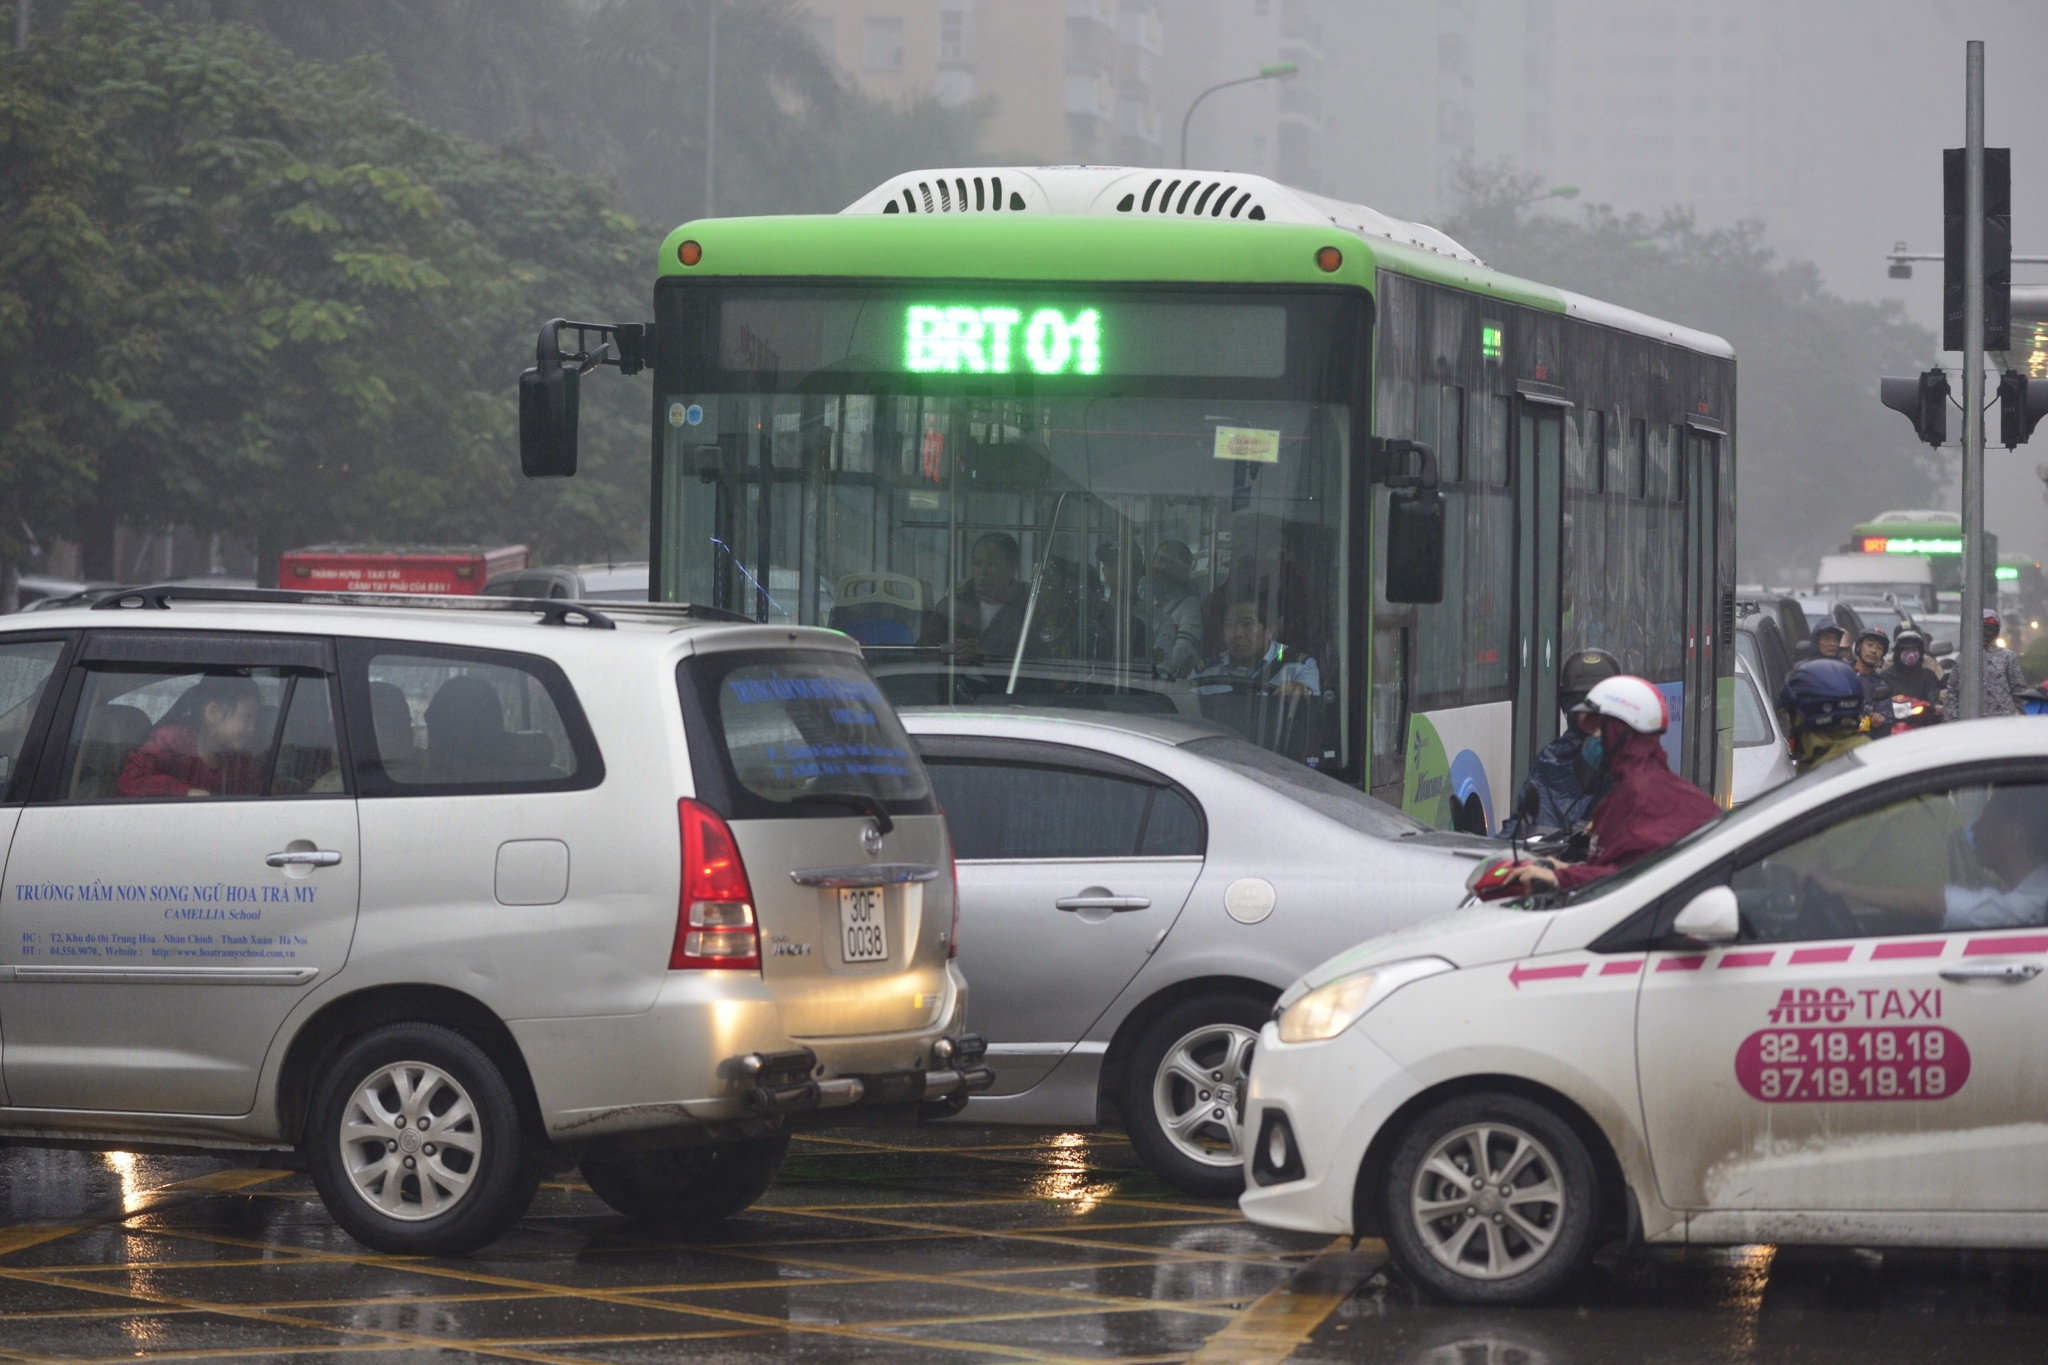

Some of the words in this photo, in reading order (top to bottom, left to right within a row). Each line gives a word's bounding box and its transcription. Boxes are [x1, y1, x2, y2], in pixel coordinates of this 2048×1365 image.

[905, 304, 1021, 374] BRT
[1026, 307, 1101, 376] 01
[15, 880, 74, 901] TRƯỜNG
[78, 878, 113, 901] MẦM
[116, 885, 147, 901] NON
[150, 885, 189, 902] SONG
[193, 882, 225, 902] NGỮ
[226, 886, 257, 902] HOA
[294, 886, 318, 902] MY
[850, 890, 876, 922] 30F
[164, 908, 226, 920] CAMELLIA
[228, 908, 262, 920] School
[847, 926, 884, 957] 0038
[1767, 987, 1850, 1023] ABC
[1858, 988, 1942, 1019] TAXI
[1759, 1029, 1945, 1063] 32.19.19.19
[1759, 1065, 1946, 1098] 37.19.19.19
